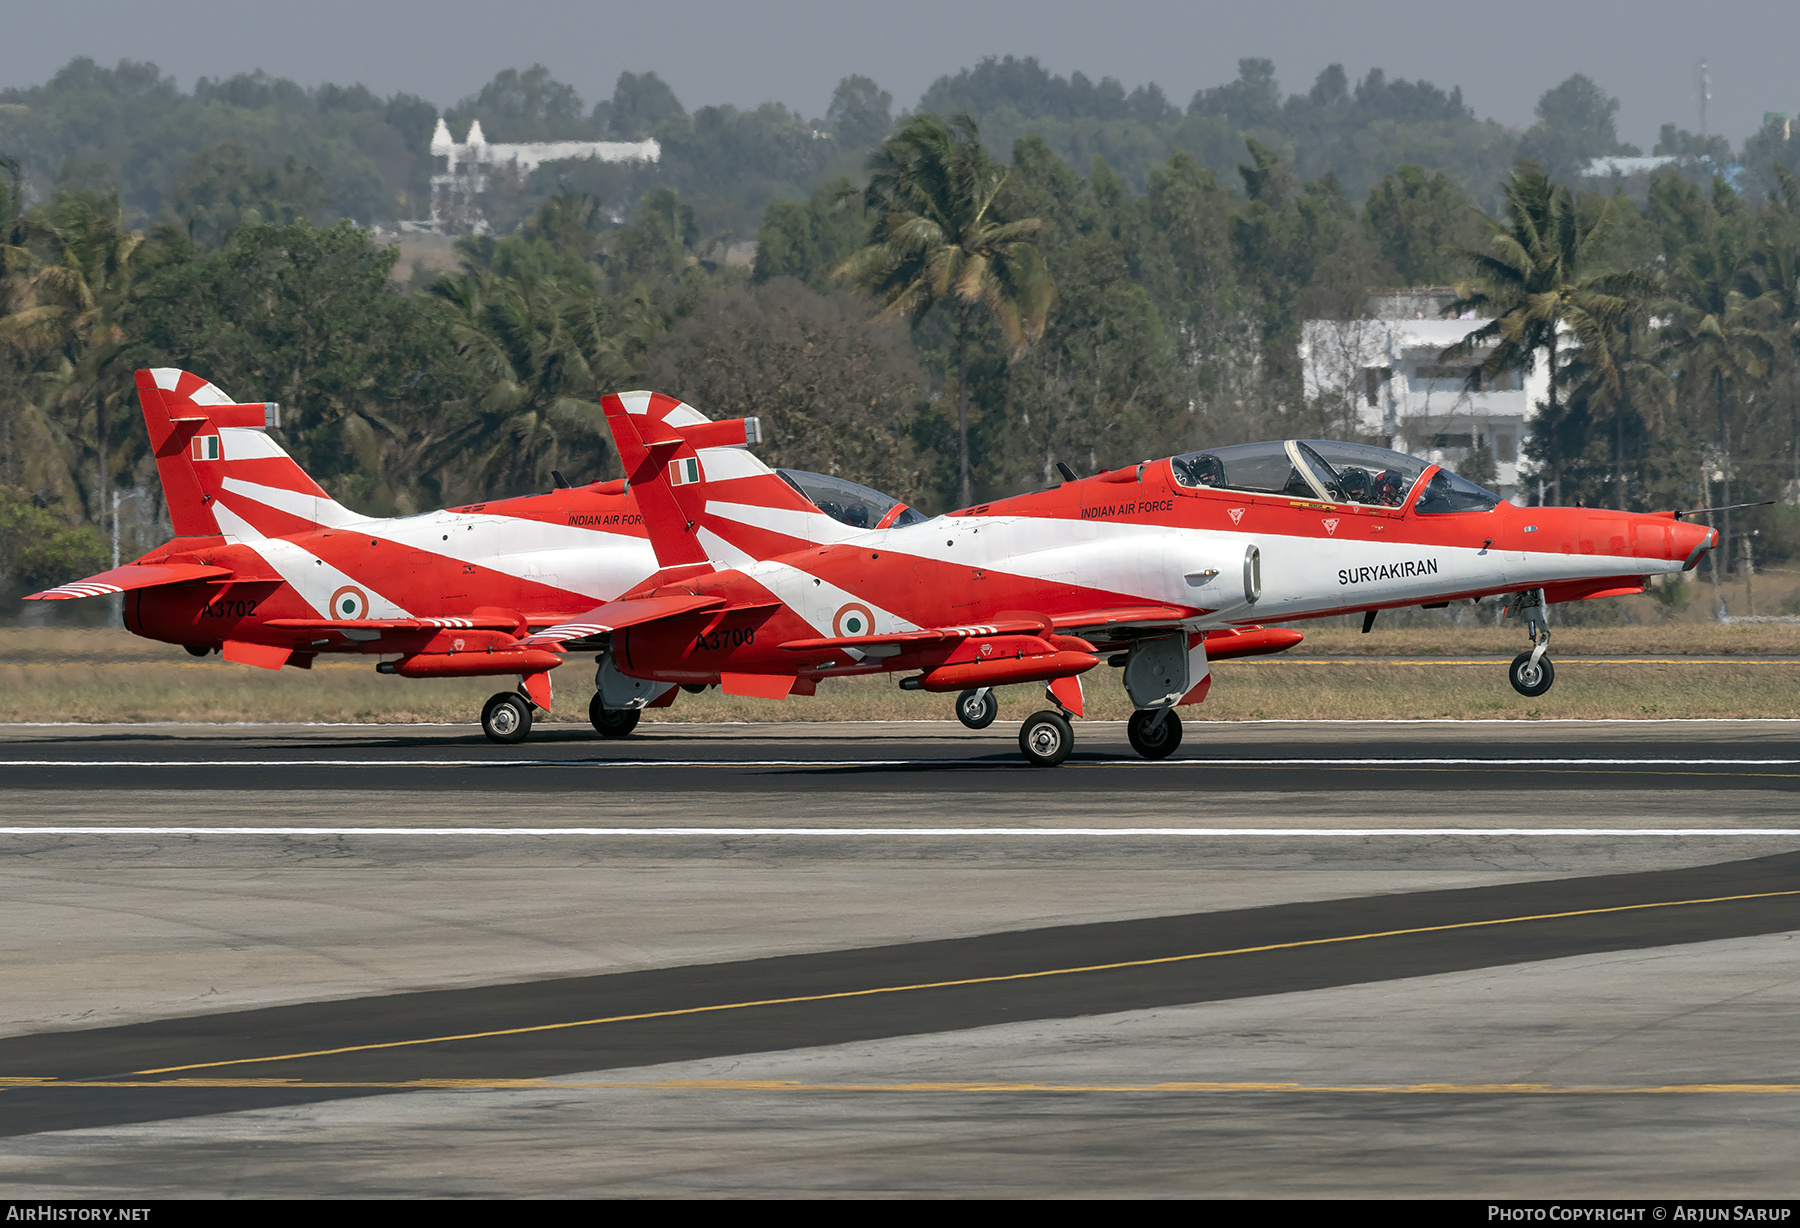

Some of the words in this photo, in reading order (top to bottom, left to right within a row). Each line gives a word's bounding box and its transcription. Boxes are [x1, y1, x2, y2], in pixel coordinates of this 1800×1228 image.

[1081, 506, 1115, 519] INDIAN
[1117, 503, 1136, 515] AIR
[1138, 500, 1173, 513] FORCE
[568, 515, 601, 526] INDIAN
[602, 515, 620, 525] AIR
[621, 514, 645, 525] FOR
[1338, 558, 1438, 585] SURYAKIRAN
[201, 600, 257, 618] A3702
[694, 627, 755, 652] A3700
